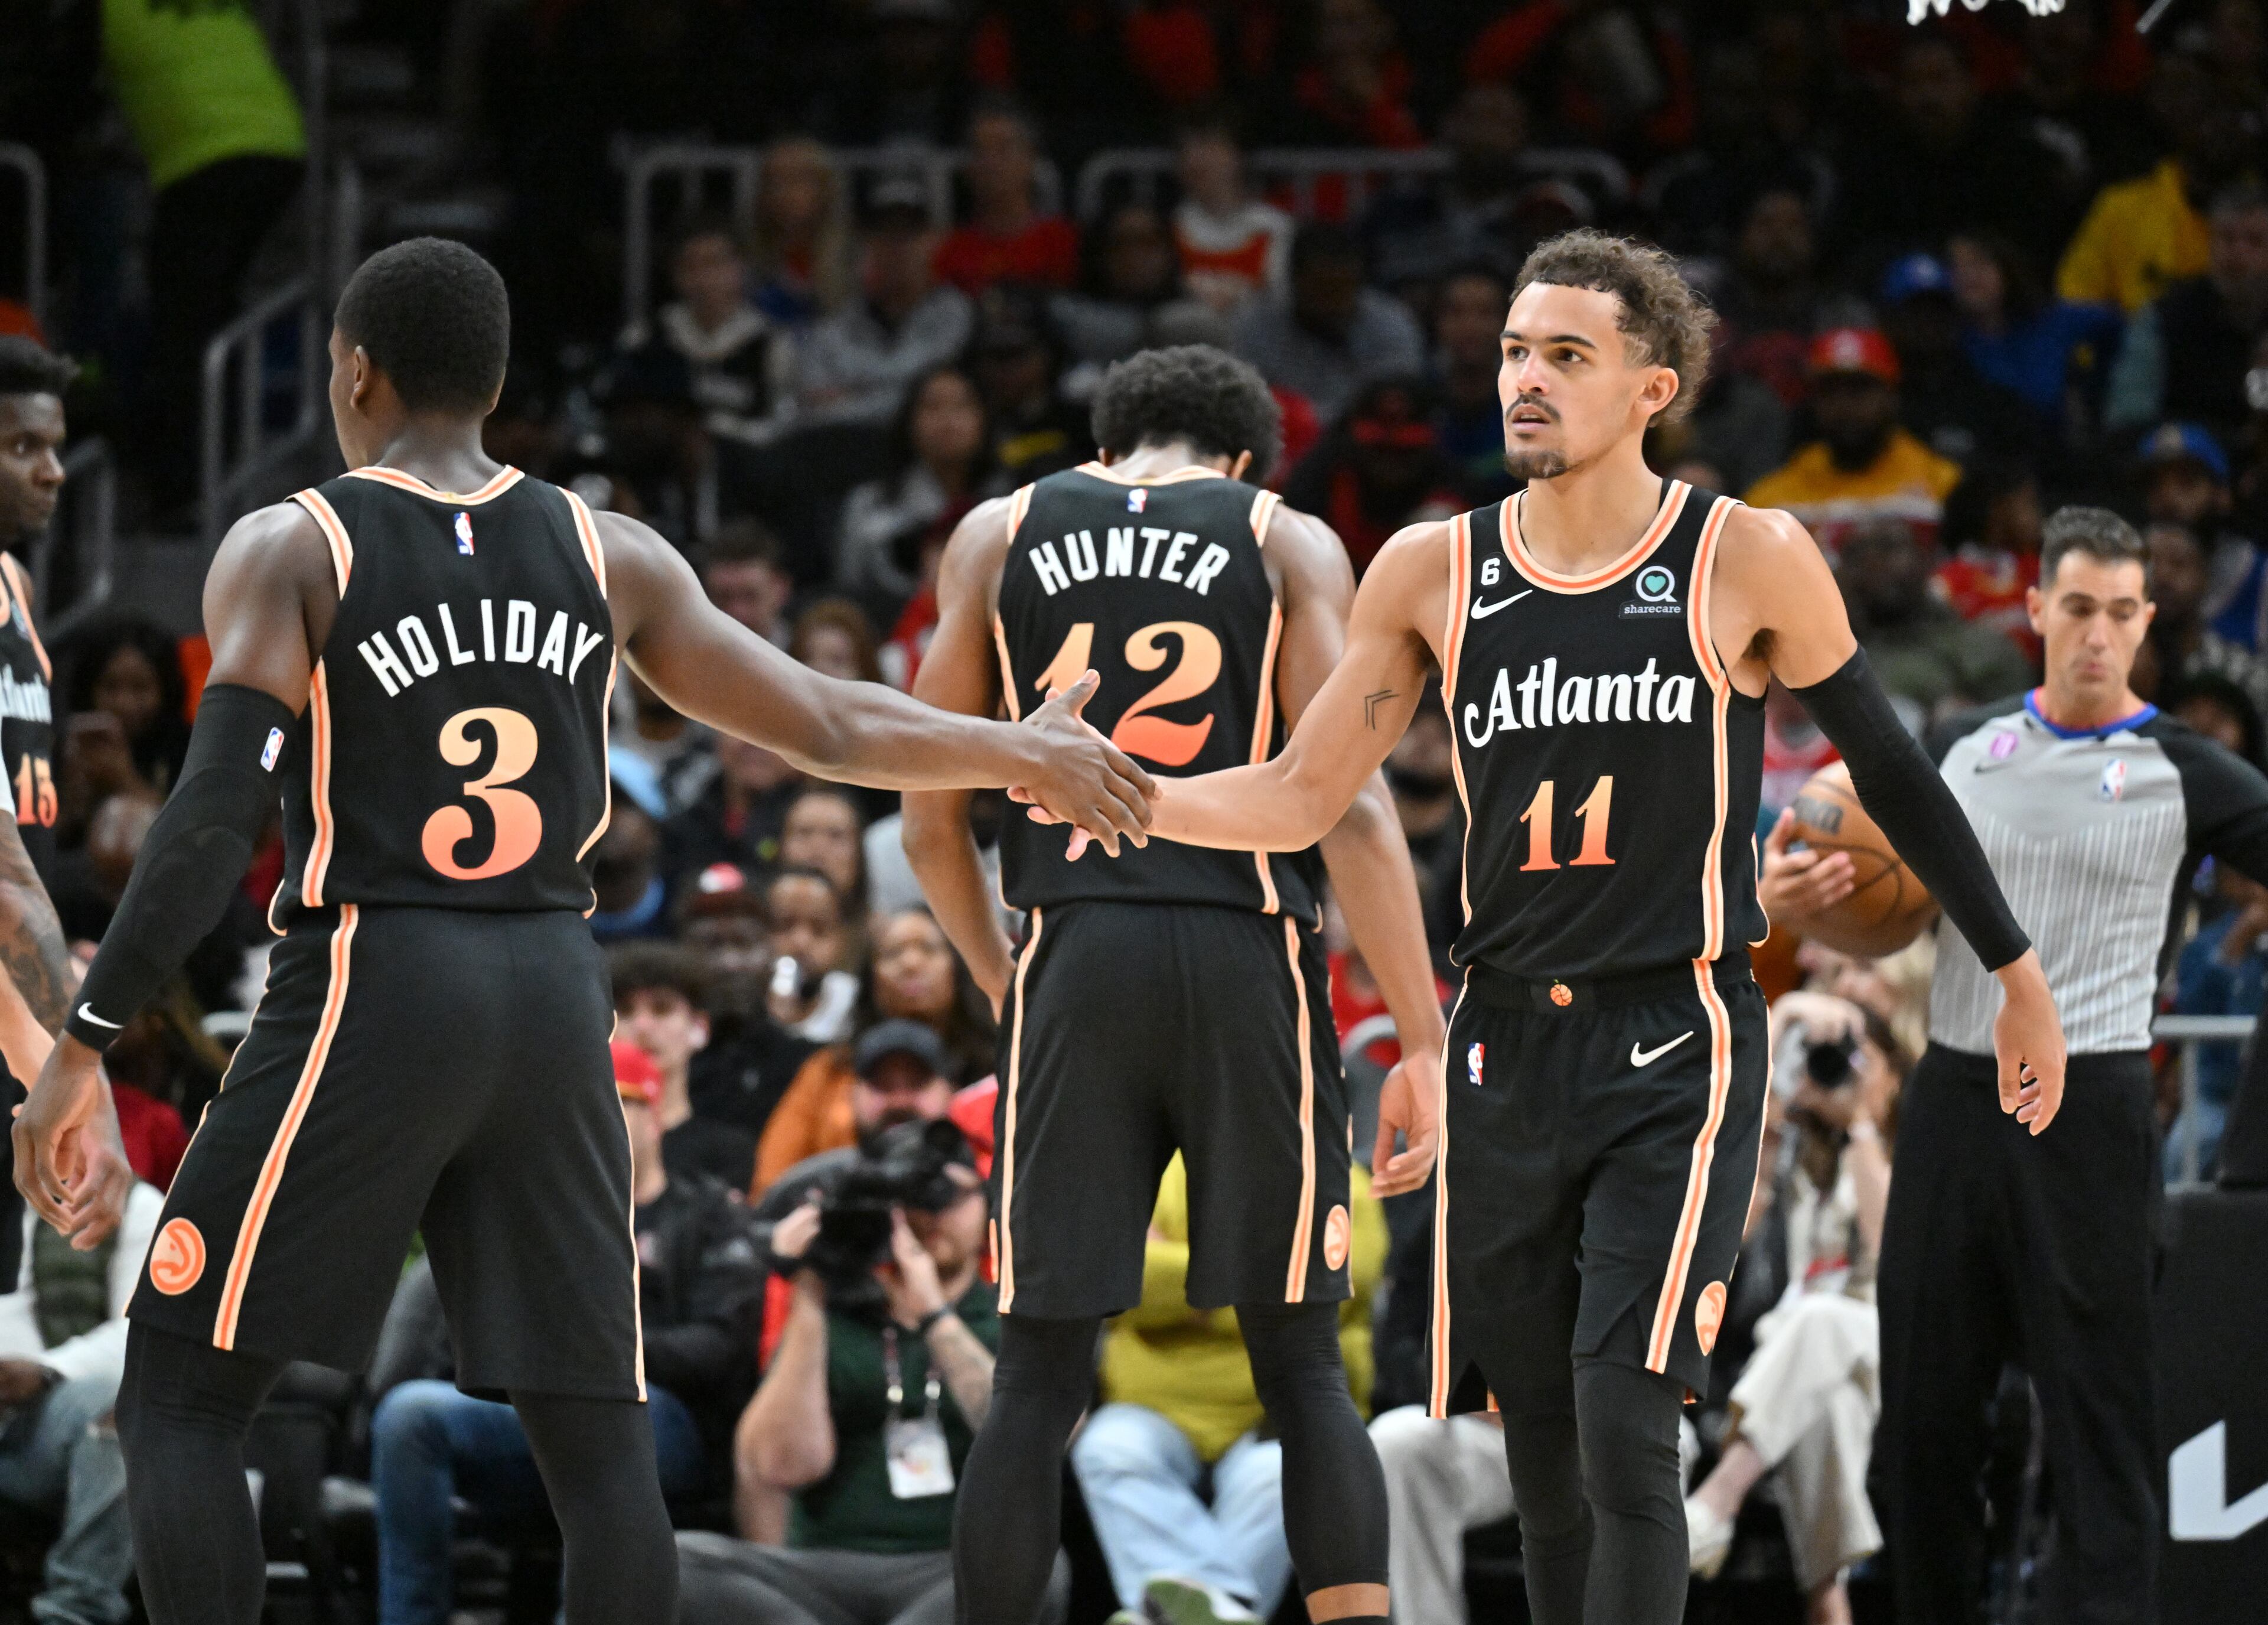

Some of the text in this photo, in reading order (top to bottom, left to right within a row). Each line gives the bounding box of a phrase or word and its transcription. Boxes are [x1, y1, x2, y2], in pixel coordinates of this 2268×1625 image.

[1029, 526, 1230, 596] HUNTER
[1480, 557, 1500, 586] 6
[357, 598, 605, 698] HOLIDAY
[1624, 604, 1682, 614] sharecare
[1464, 656, 1696, 748] Atlanta
[421, 707, 542, 880] 3
[1520, 775, 1616, 871] 11
